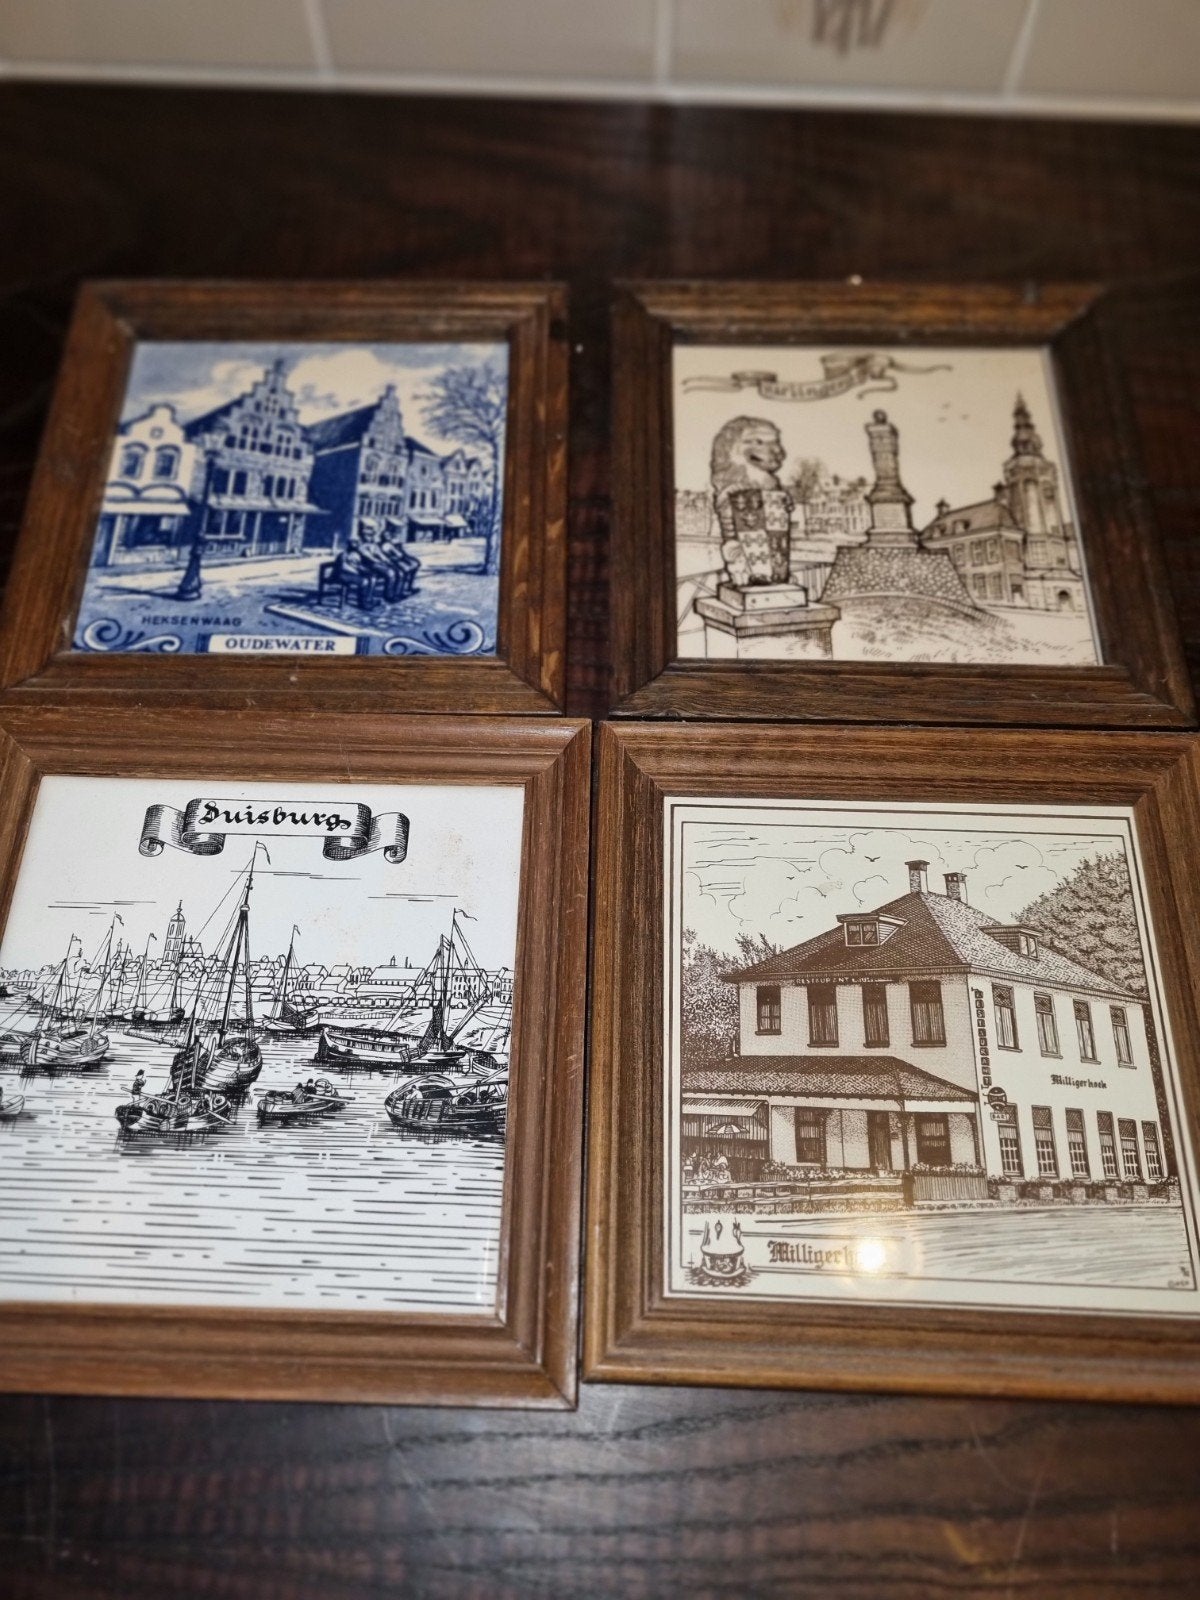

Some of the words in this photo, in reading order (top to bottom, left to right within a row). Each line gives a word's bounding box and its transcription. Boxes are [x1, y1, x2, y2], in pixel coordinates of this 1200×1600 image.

[141, 615, 242, 627] HEKSENWAAG
[225, 637, 336, 652] OUDEWATER
[198, 800, 352, 832] Duisburg
